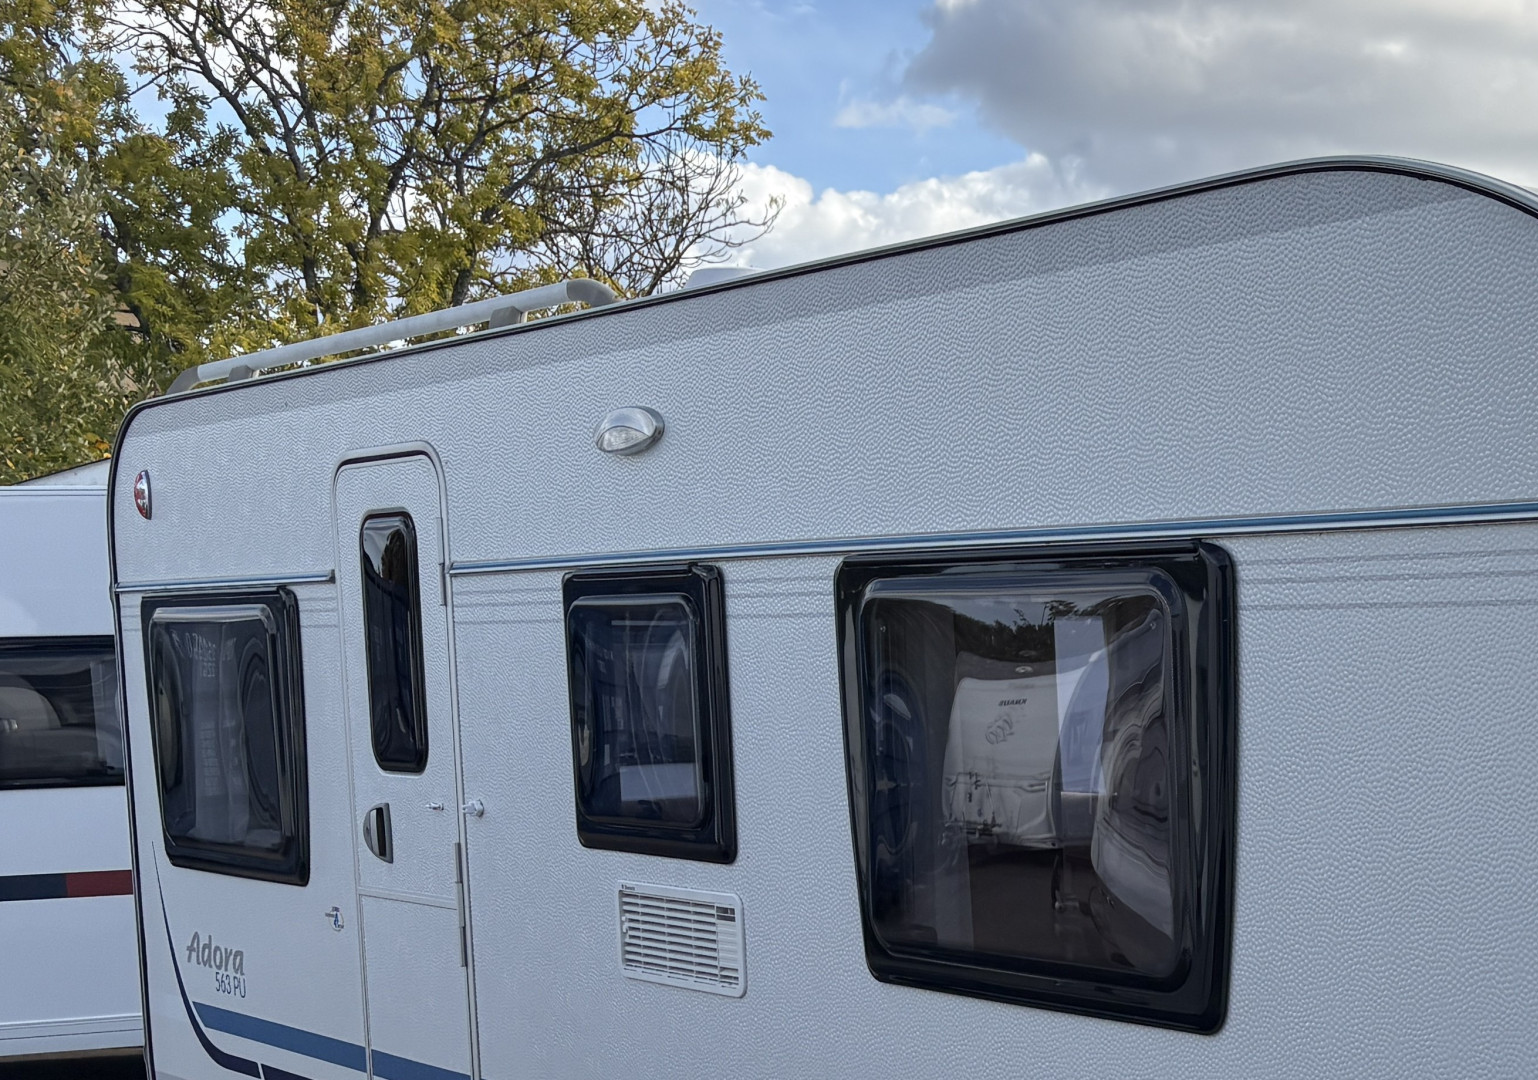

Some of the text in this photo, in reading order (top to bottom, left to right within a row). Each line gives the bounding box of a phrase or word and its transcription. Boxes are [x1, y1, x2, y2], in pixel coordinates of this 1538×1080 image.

[186, 931, 245, 976] Adora
[215, 972, 246, 998] 563 PU
